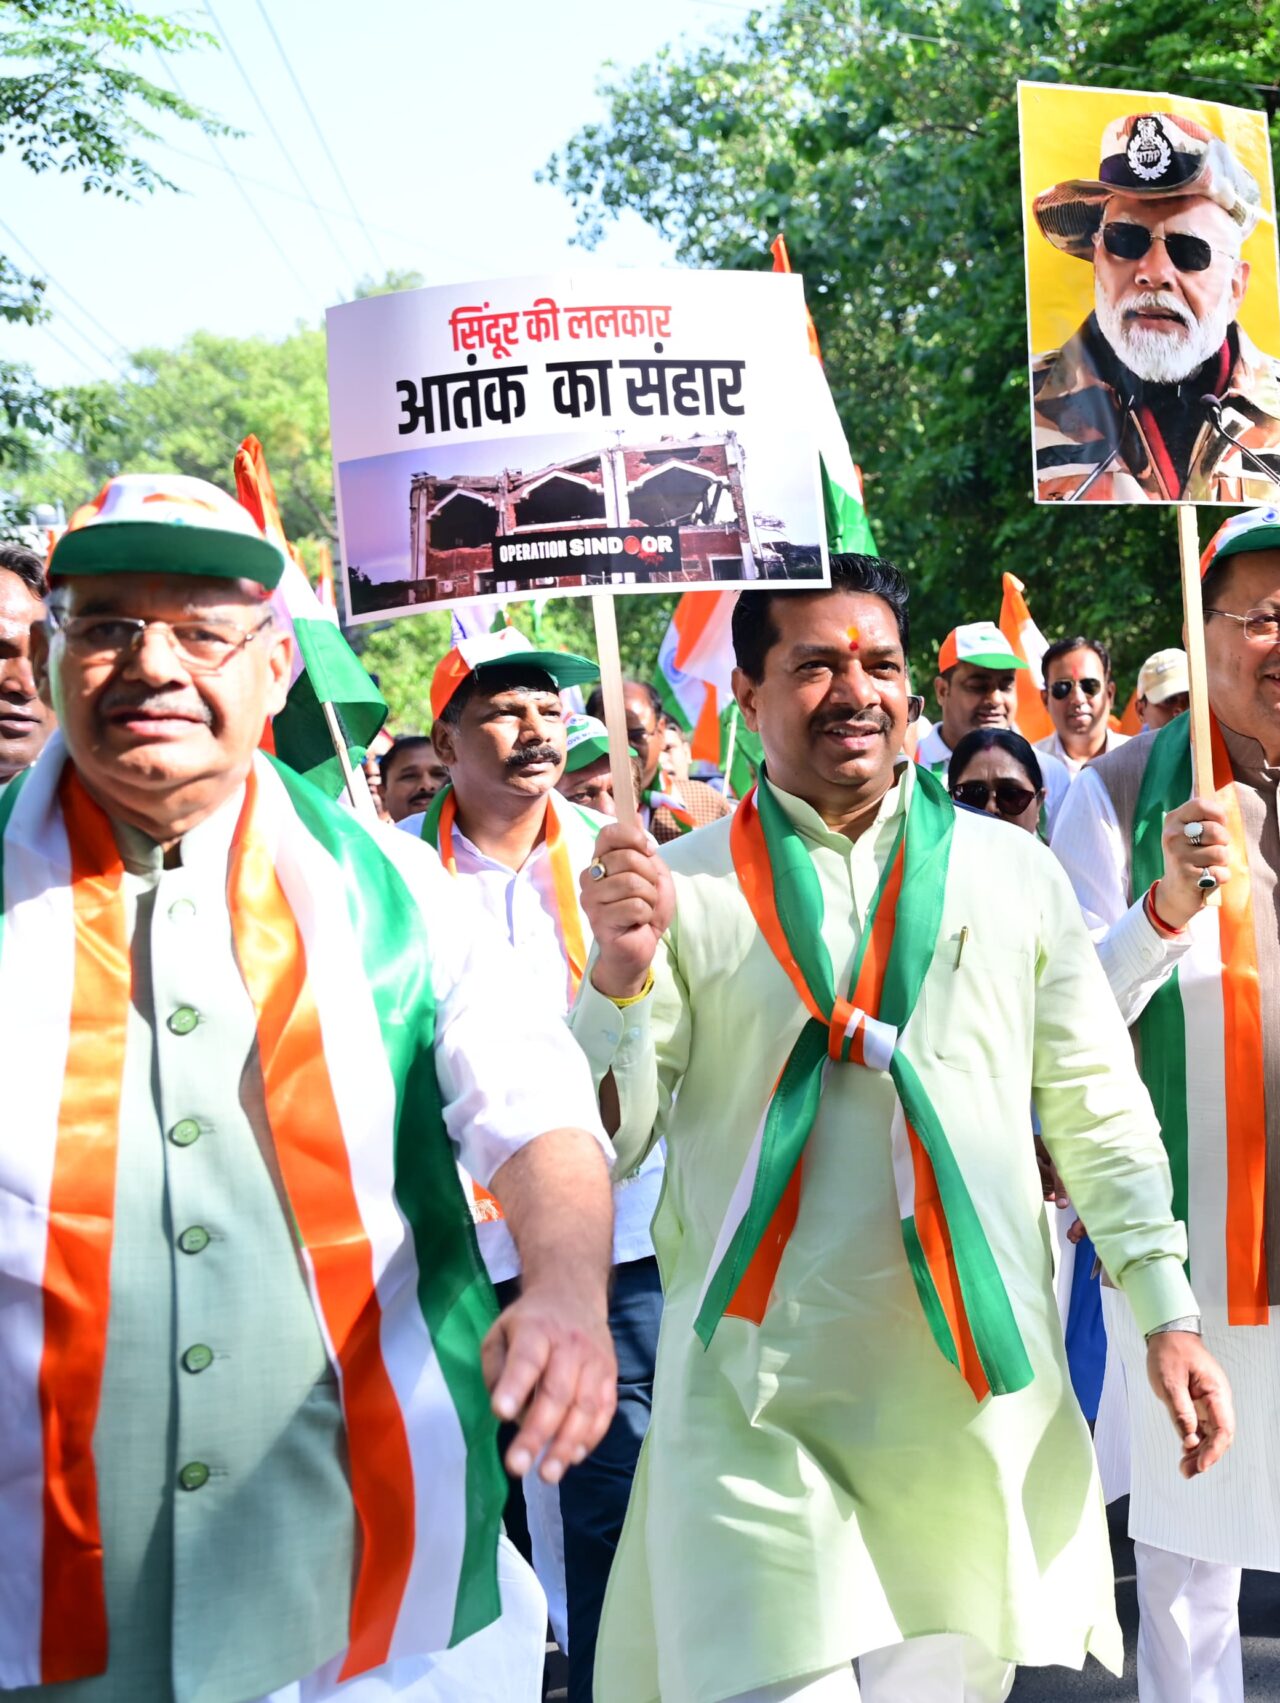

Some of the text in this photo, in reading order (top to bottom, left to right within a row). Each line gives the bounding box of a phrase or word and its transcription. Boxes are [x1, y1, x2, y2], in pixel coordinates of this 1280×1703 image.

[448, 297, 672, 360] सिंदूर की ललकार
[396, 341, 746, 435] आतंक का संहार
[499, 539, 568, 563] OPERATION
